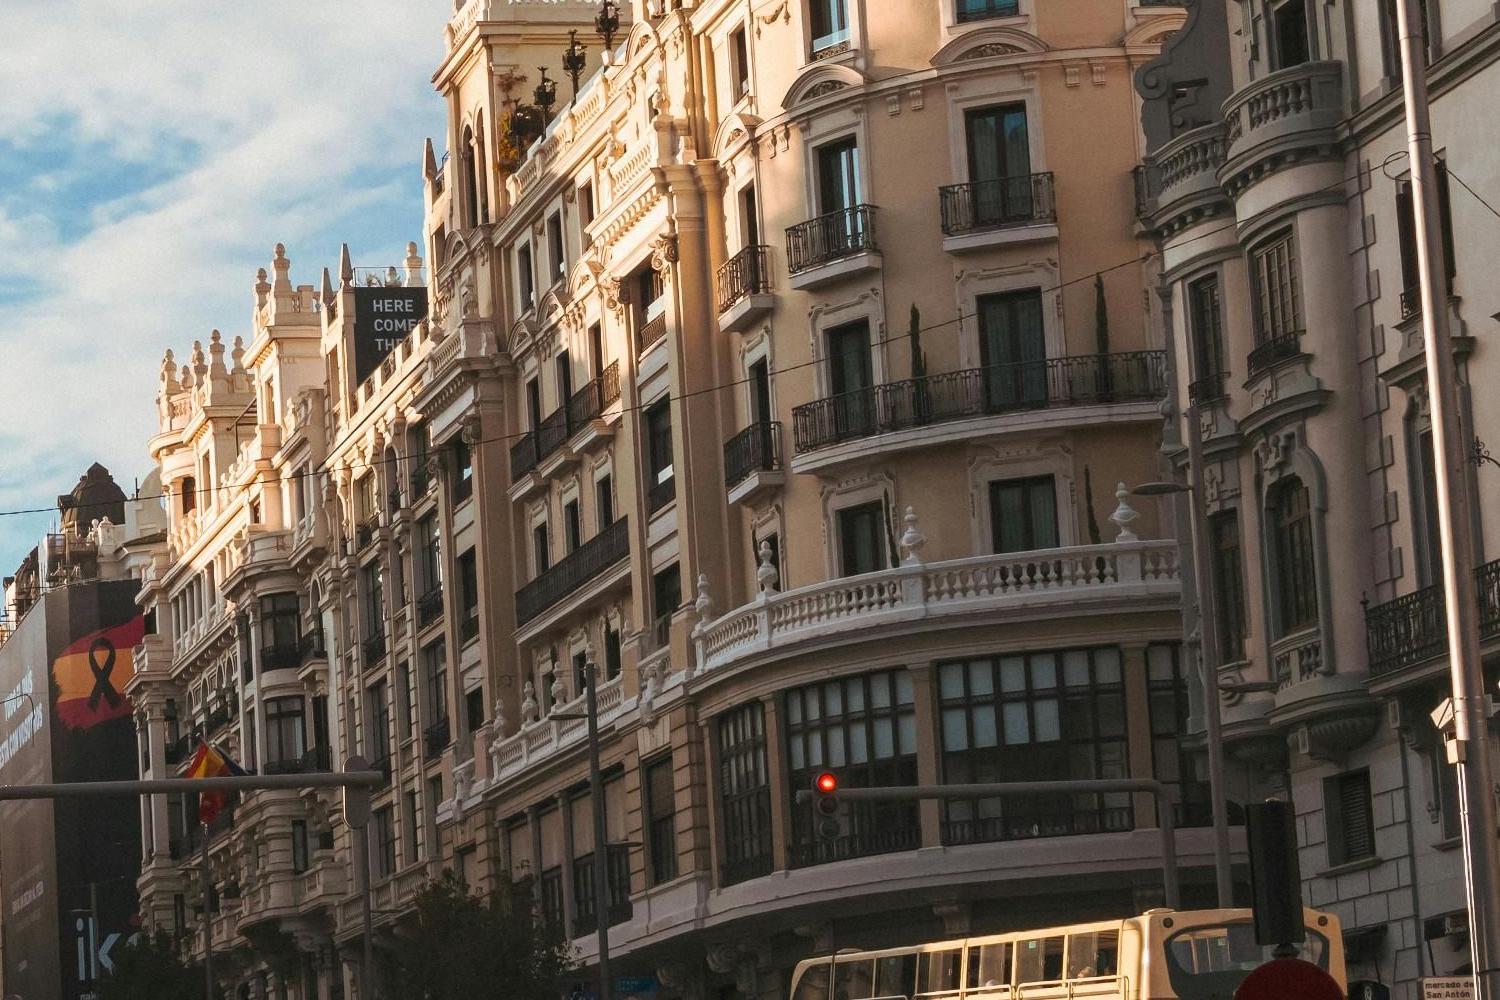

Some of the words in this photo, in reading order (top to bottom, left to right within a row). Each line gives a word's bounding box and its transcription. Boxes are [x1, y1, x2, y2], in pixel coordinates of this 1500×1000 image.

[373, 300, 414, 312] HERE
[375, 339, 403, 351] TH
[1425, 981, 1461, 989] mercado
[1426, 991, 1442, 999] San
[1445, 990, 1470, 998] Antón
